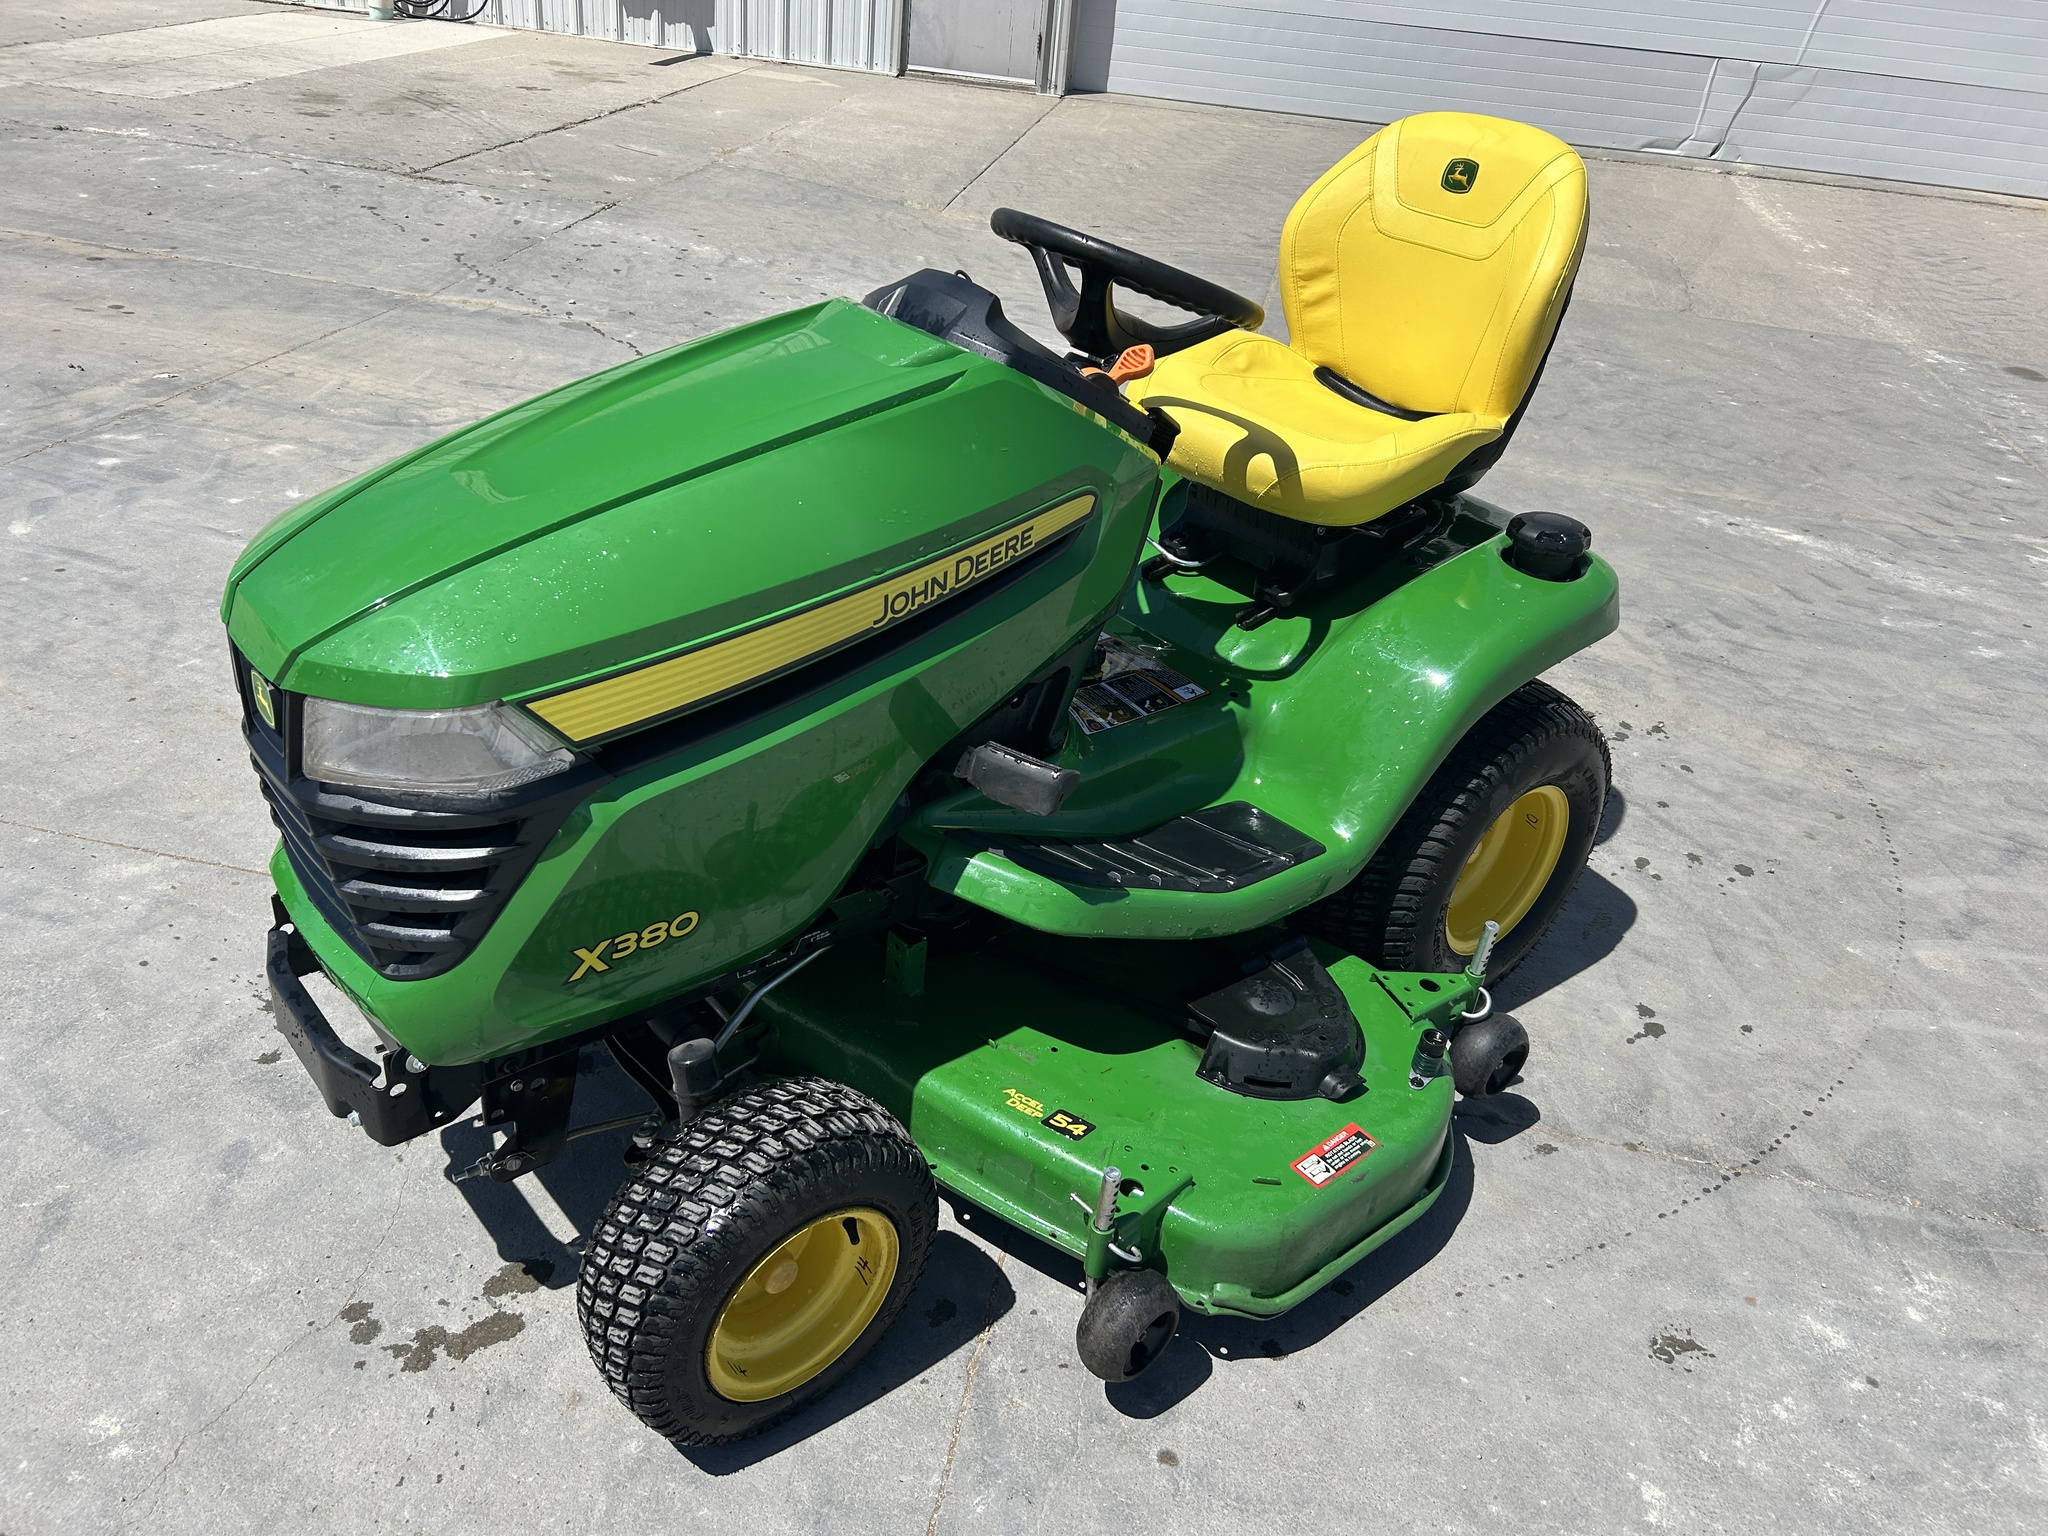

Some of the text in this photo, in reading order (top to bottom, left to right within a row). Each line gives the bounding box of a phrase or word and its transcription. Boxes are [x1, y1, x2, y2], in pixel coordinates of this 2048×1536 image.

[872, 525, 1036, 627] JOHN DEERE
[564, 910, 700, 984] X380
[1002, 1088, 1044, 1112] ACCEL
[1005, 1098, 1044, 1118] DEEP
[1048, 1112, 1088, 1136] 54
[1325, 1129, 1349, 1147] DANGER
